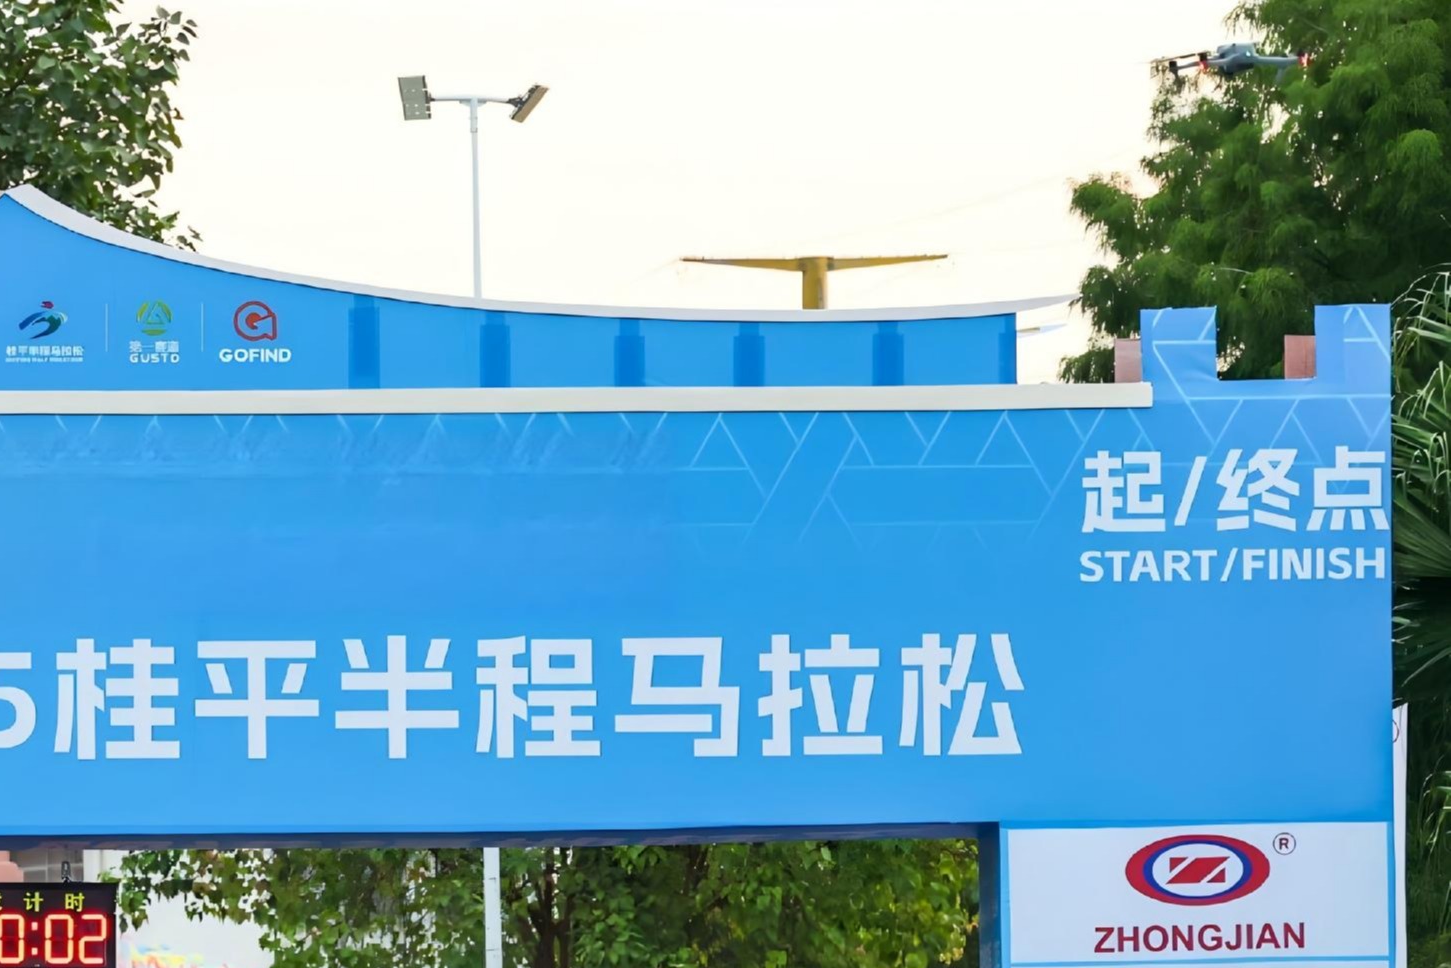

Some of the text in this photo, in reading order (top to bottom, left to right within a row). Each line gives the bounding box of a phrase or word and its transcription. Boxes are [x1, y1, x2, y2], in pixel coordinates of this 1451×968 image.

[129, 353, 180, 363] GUSTO
[218, 348, 291, 363] GOFIND
[1081, 445, 1390, 533] 起/终点
[1079, 547, 1386, 582] START/FINISH
[1093, 922, 1306, 953] ZHONGJIAN
